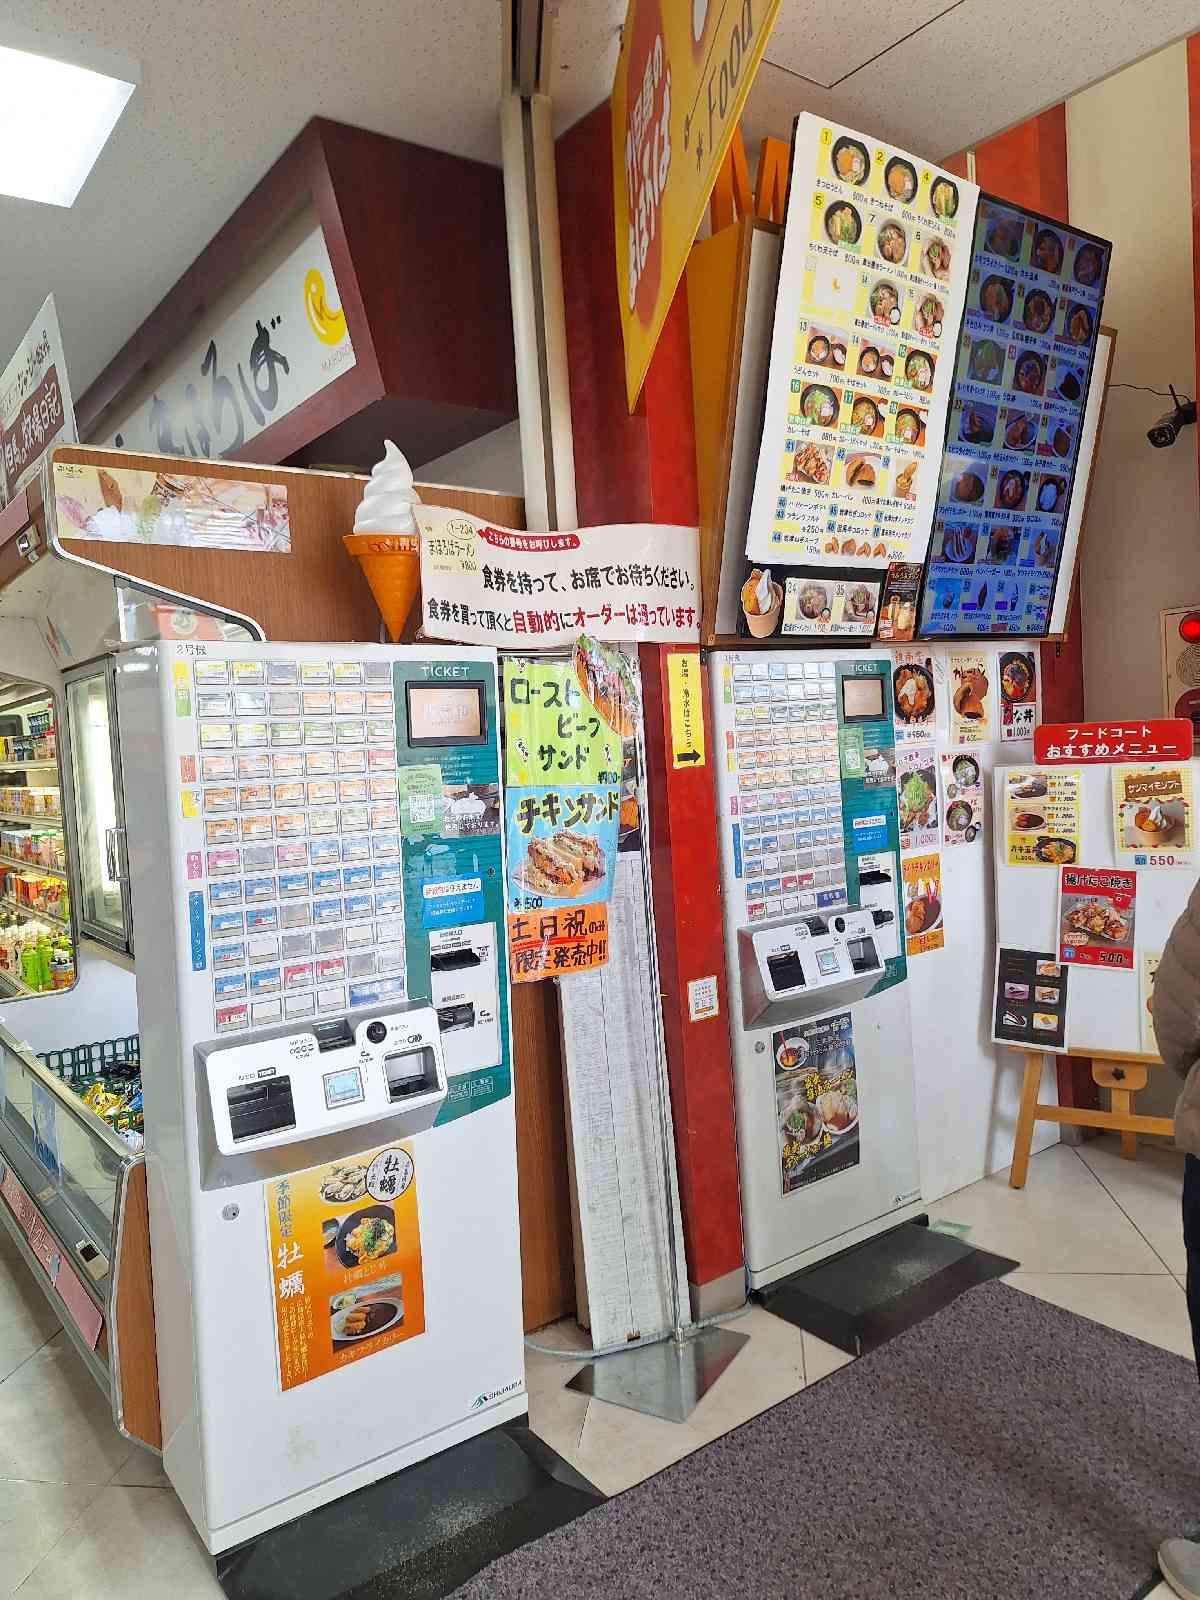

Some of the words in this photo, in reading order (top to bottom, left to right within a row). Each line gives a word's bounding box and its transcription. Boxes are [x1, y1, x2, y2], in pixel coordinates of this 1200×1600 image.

[482, 563, 697, 595] 食券を持って、お席でお待ちください。
[427, 597, 701, 634] 食券を買って頂くと自動的にオーダーは通っています。
[421, 666, 471, 677] TICKET
[849, 663, 878, 673] TICKET
[510, 678, 581, 708] ロースト
[557, 713, 601, 738] ビーフ
[1067, 725, 1152, 740] フードコート
[538, 744, 591, 772] サンド
[1046, 743, 1177, 758] おすすめメニュー
[518, 791, 620, 834] チキンサンド
[1149, 855, 1175, 866] 550
[1064, 872, 1134, 889] 揚げたこ焼き
[511, 909, 607, 942] 土日祝のみ
[515, 939, 607, 973] 限定発売中!!
